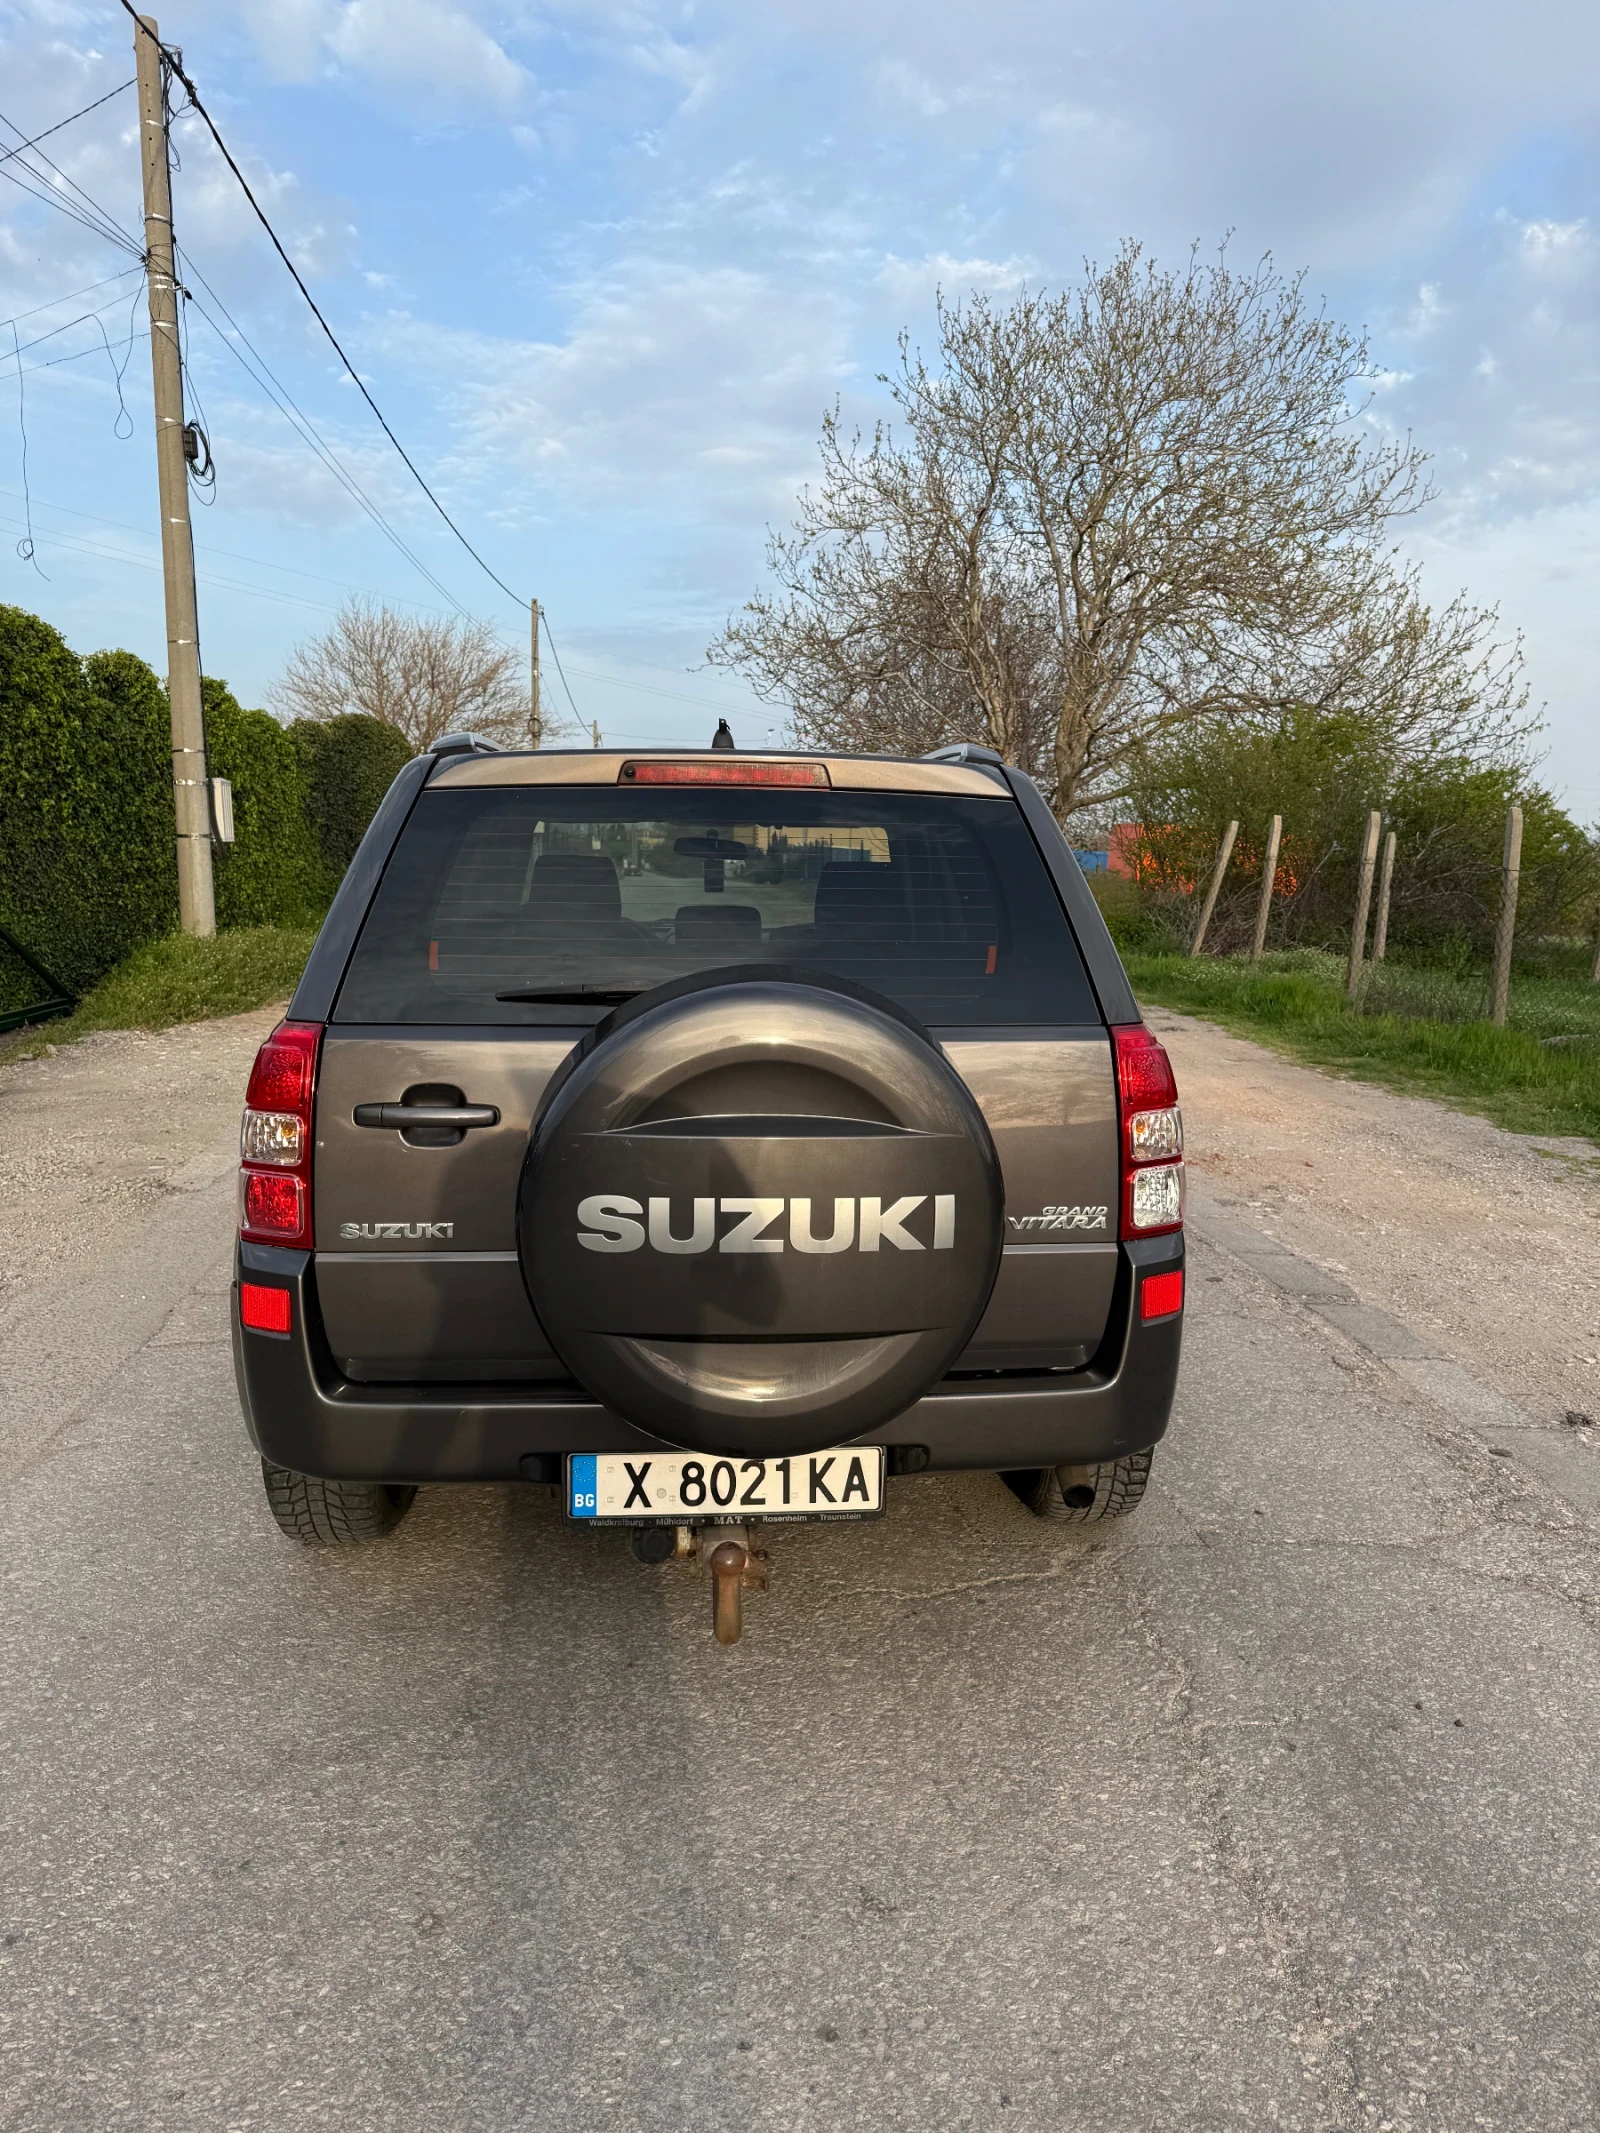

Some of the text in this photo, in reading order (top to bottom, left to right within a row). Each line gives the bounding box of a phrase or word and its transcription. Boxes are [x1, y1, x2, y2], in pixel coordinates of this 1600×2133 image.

[1042, 1206, 1108, 1216] GRAND
[577, 1194, 955, 1254] SUZUKI
[1008, 1215, 1107, 1230] VITARA
[340, 1223, 454, 1239] SUZUKI
[623, 1456, 870, 1508] X 8021 KA
[574, 1493, 595, 1507] BG
[656, 1517, 694, 1526] Mühldorf
[714, 1516, 743, 1525] MAT
[762, 1515, 808, 1523] Rosenheim
[819, 1513, 862, 1521] Traunstein
